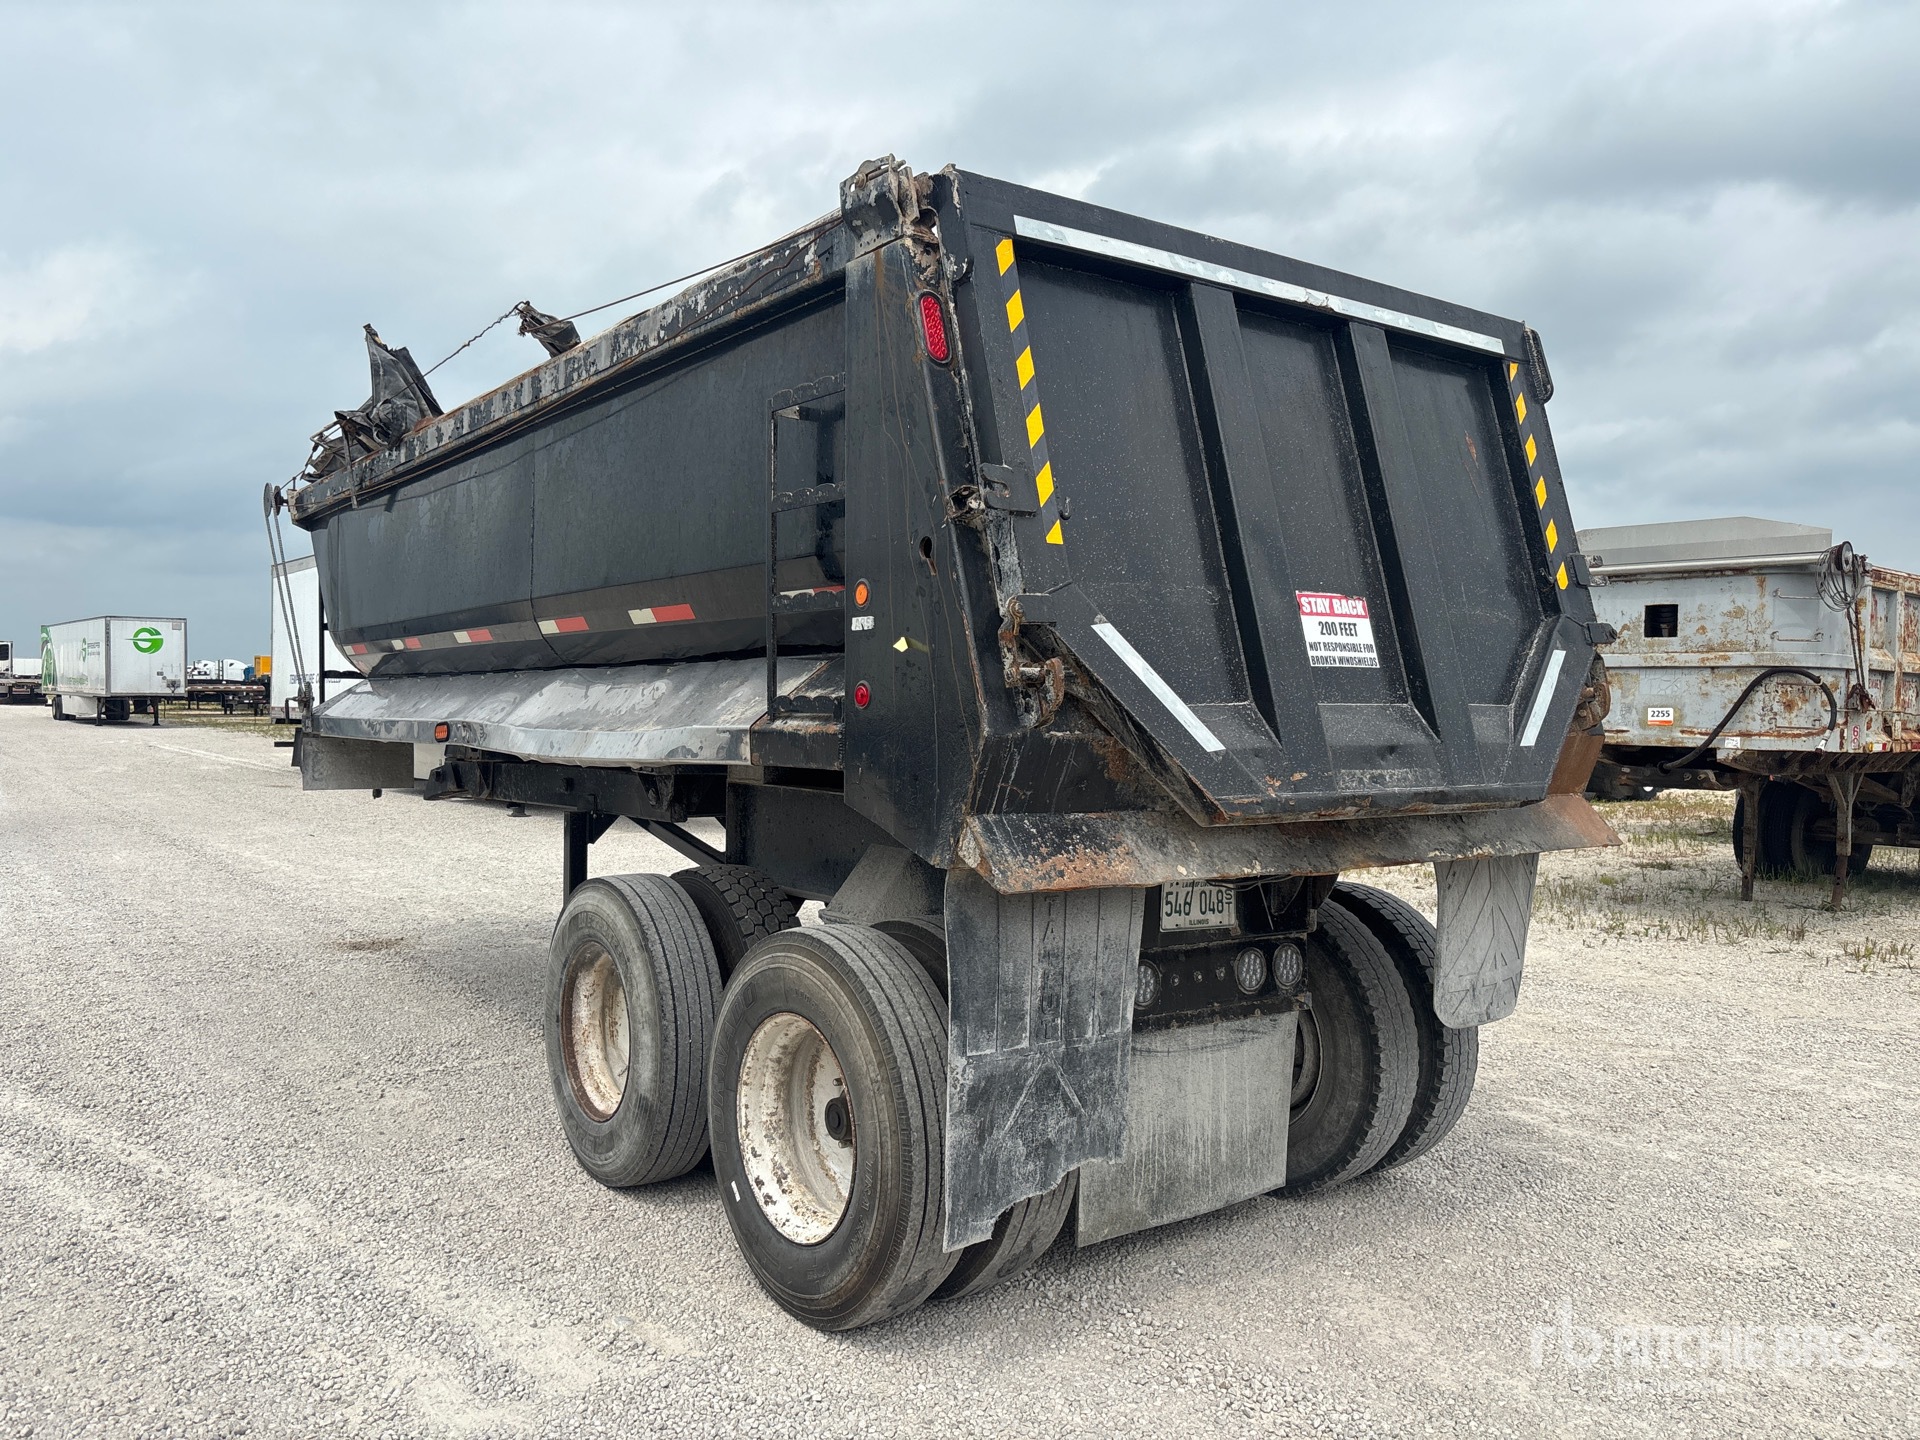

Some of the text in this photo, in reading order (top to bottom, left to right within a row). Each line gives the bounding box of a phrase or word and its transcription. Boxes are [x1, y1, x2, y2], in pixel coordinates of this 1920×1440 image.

[1300, 597, 1365, 615] STAY BACK
[1318, 621, 1358, 637] 200 FEET
[1308, 642, 1375, 654] NOT RESPONSIBLE FOR
[1310, 655, 1377, 667] BROKEN WINDSHIELDS
[1650, 710, 1671, 718] 2255
[1164, 890, 1193, 917] 546
[1199, 889, 1224, 915] 048
[1188, 918, 1210, 926] ILLINOIS
